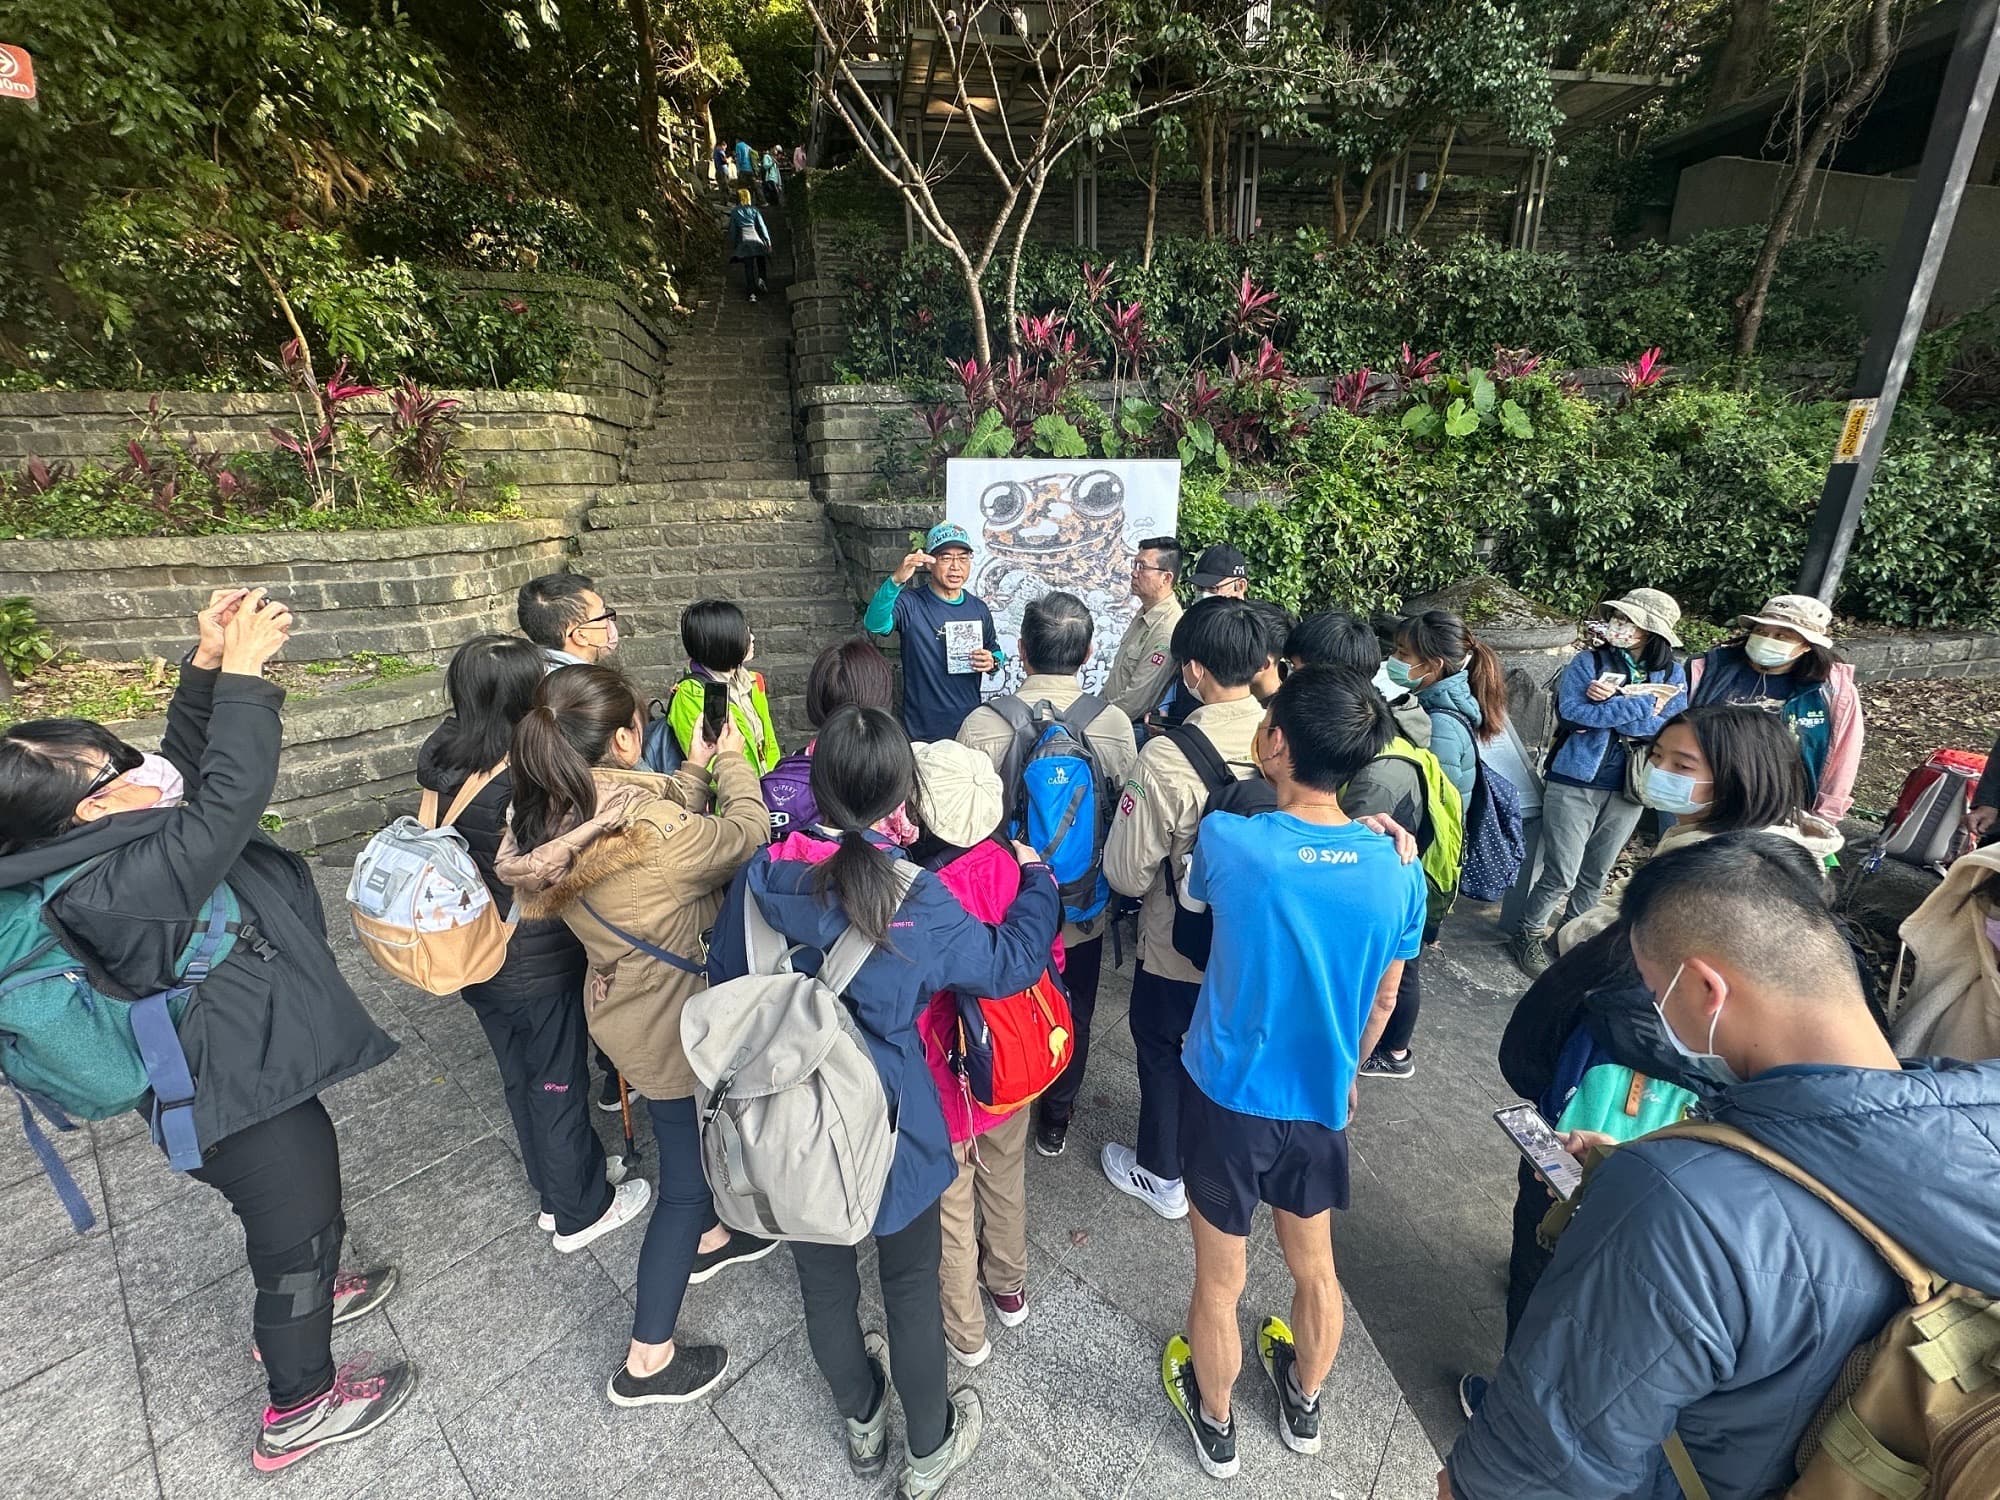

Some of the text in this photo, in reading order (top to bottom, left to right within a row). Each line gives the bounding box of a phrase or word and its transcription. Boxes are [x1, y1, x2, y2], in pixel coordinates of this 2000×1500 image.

[1152, 654, 1164, 665] 02
[1122, 796, 1134, 814] 02
[1320, 848, 1358, 865] SYM
